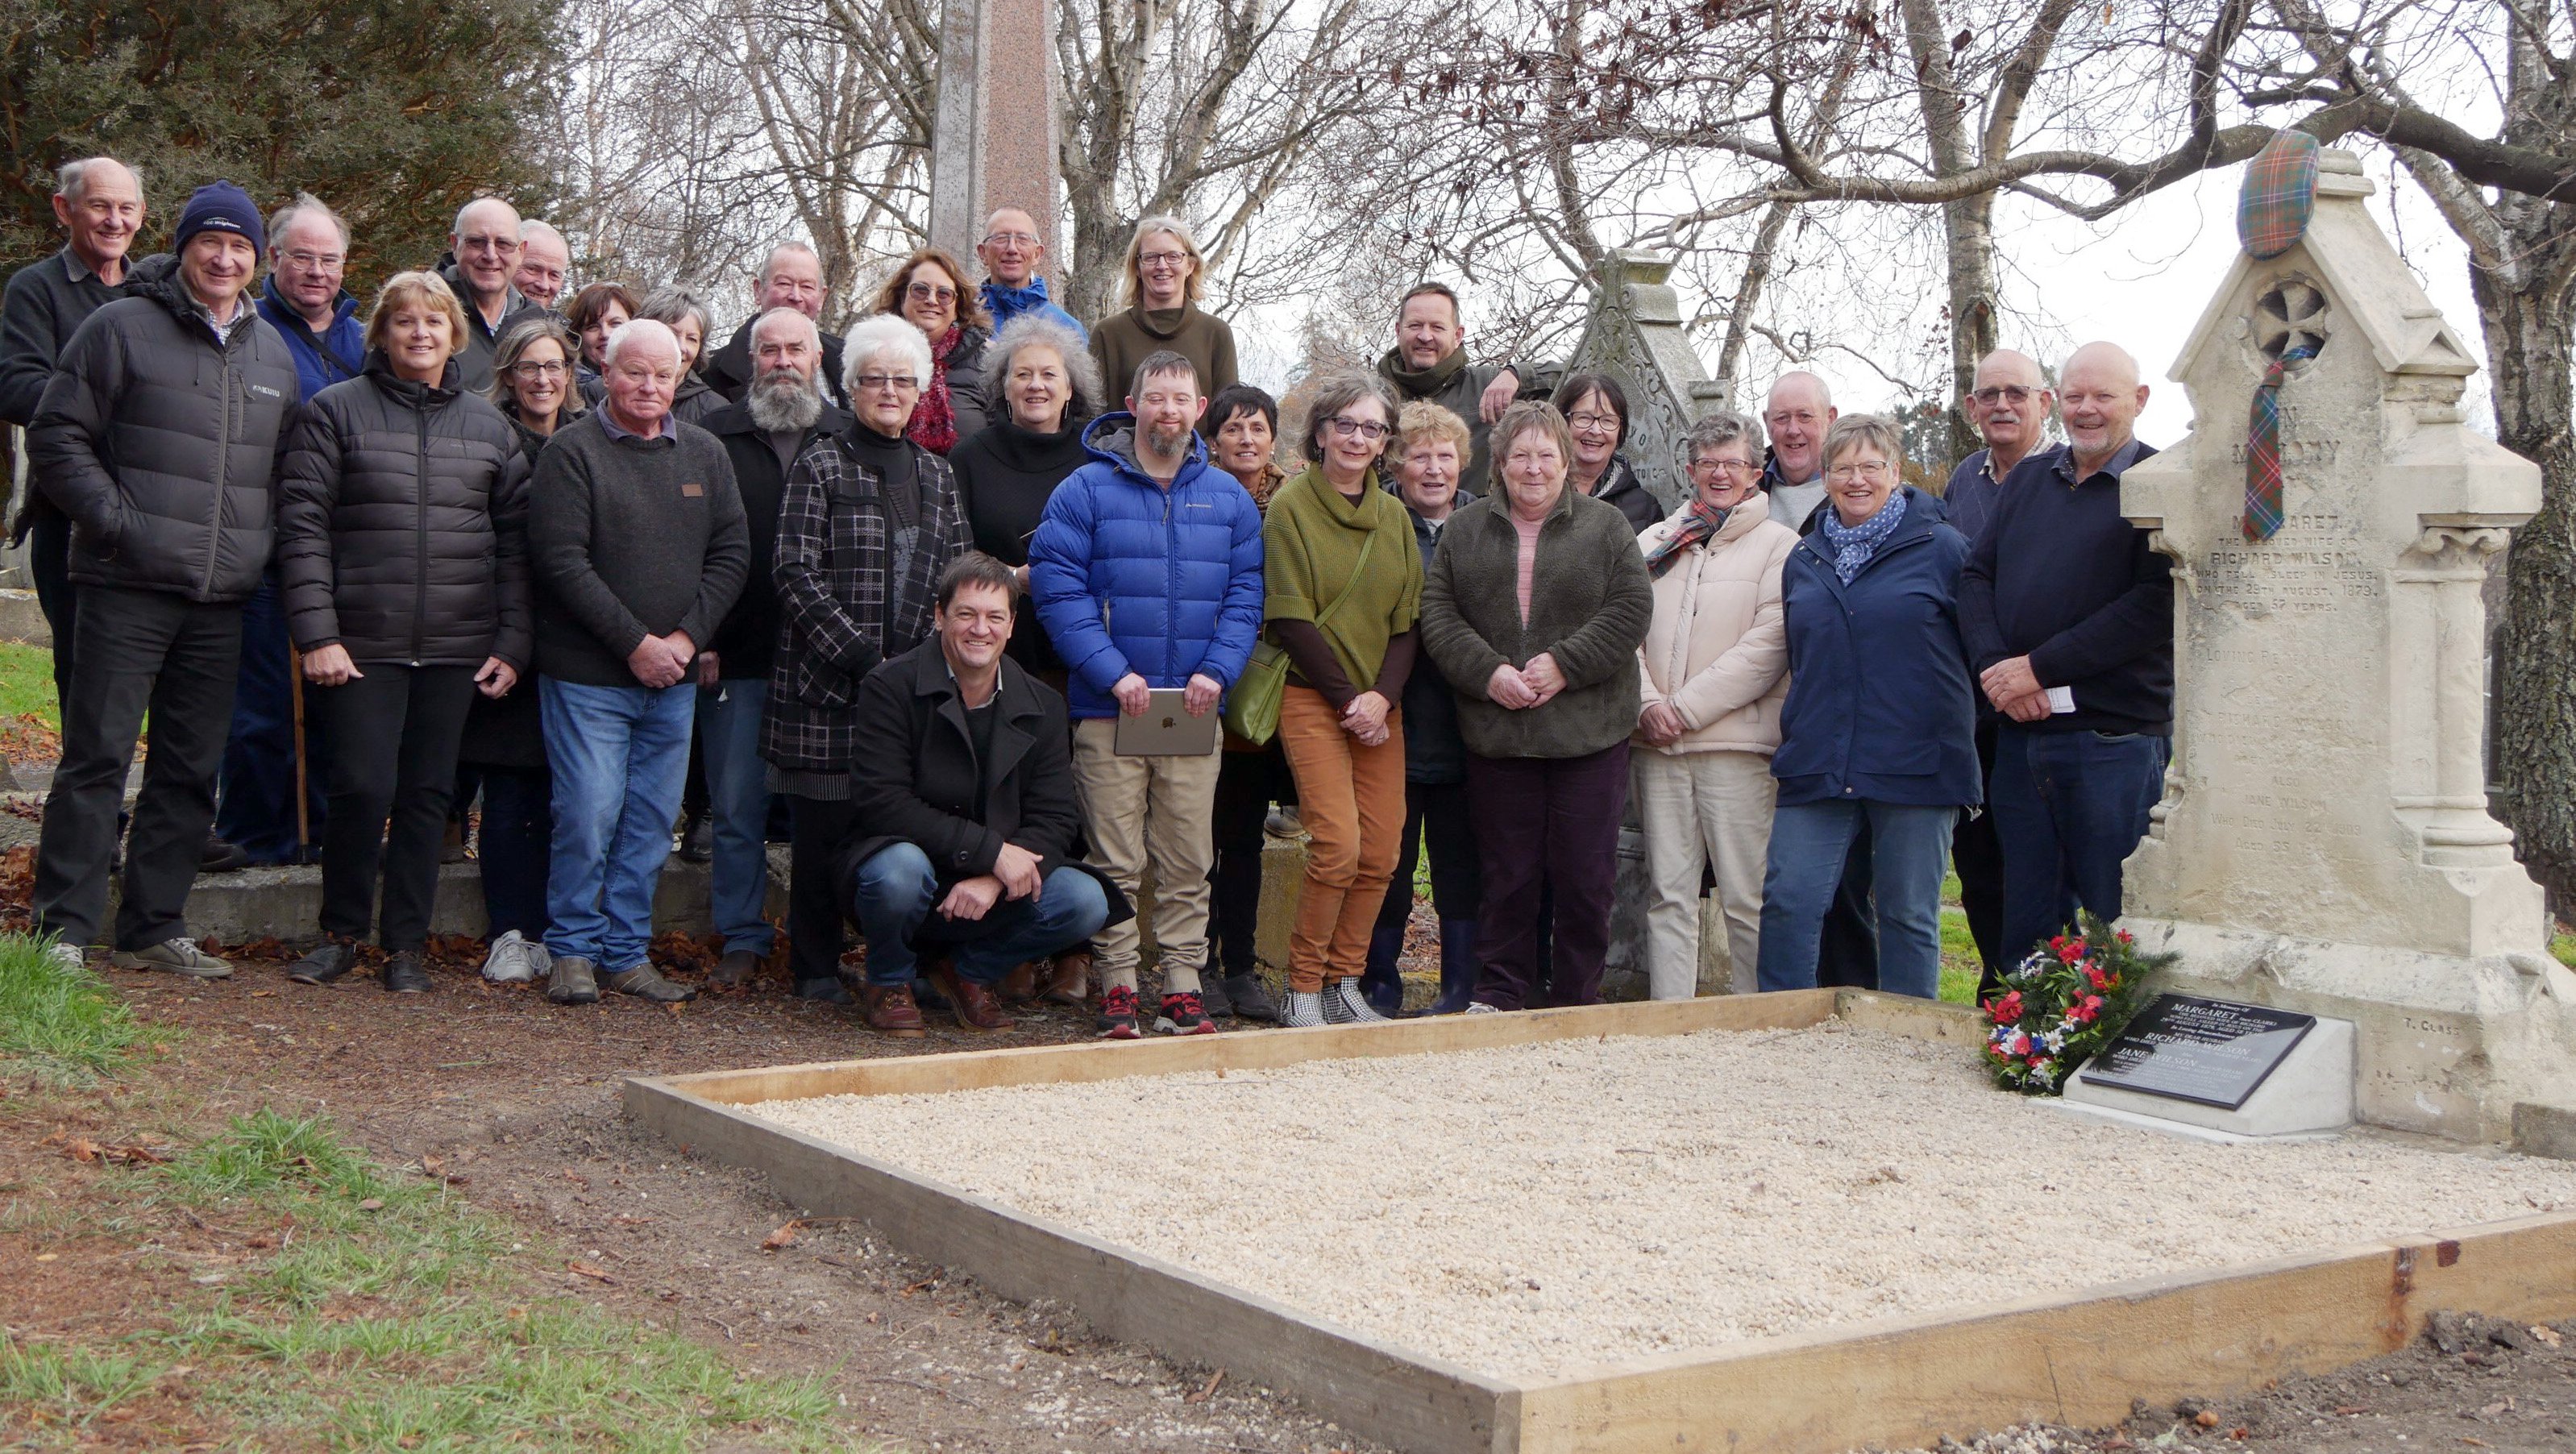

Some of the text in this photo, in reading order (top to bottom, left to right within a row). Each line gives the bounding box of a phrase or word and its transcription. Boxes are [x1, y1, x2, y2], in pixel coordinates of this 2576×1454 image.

[261, 386, 280, 397] KUIU
[2218, 537, 2239, 546] THE
[2303, 536, 2333, 546] WIFE
[2211, 551, 2283, 565] RICHARD
[2196, 569, 2218, 579] WHO
[2226, 570, 2255, 580] FELL
[2272, 775, 2301, 787] ALSO
[2171, 1003, 2240, 1020] MARGARET
[2174, 1019, 2201, 1028] AUGUST
[2144, 1032, 2200, 1047] RICHARD
[2203, 1042, 2252, 1056] WILSON
[2117, 1048, 2149, 1058] JANE
[2151, 1053, 2198, 1067] WILSON
